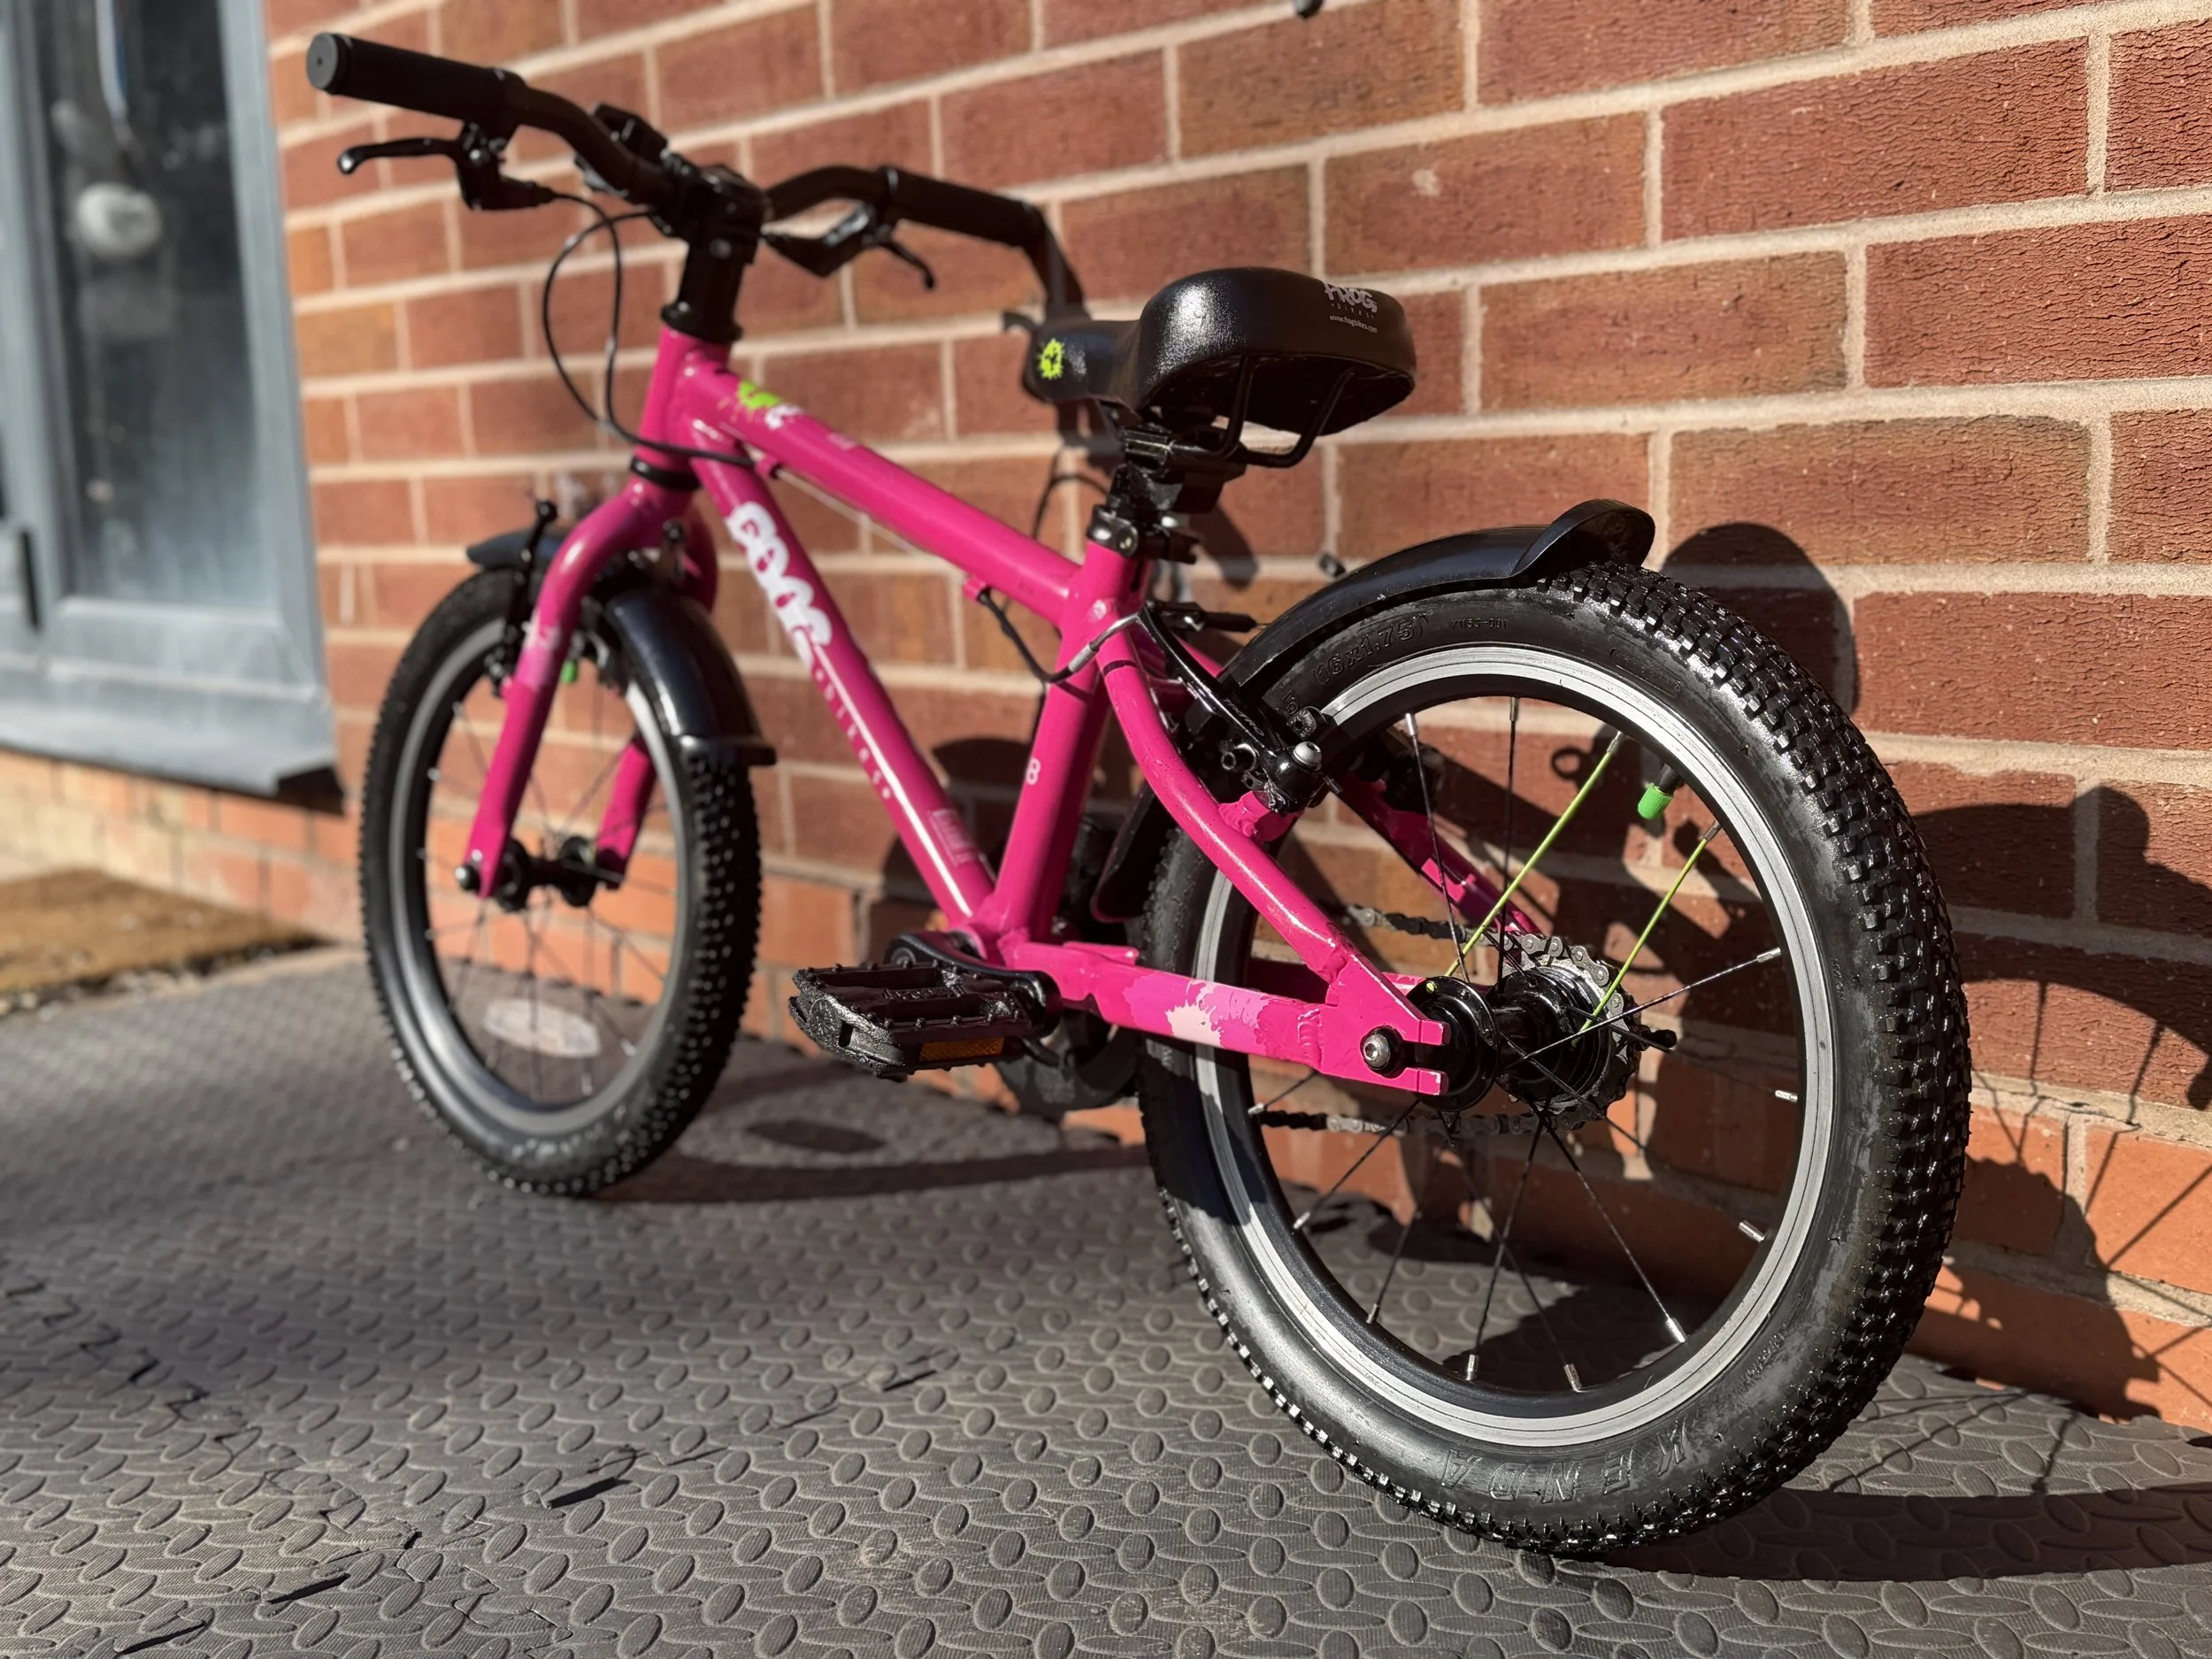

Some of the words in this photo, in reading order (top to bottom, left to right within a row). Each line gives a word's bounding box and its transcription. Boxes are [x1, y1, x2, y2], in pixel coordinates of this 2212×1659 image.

[1325, 284, 1378, 313] FROG
[1329, 314, 1378, 334] www.frogbikes.com
[1440, 1417, 1686, 1503] KENDA
